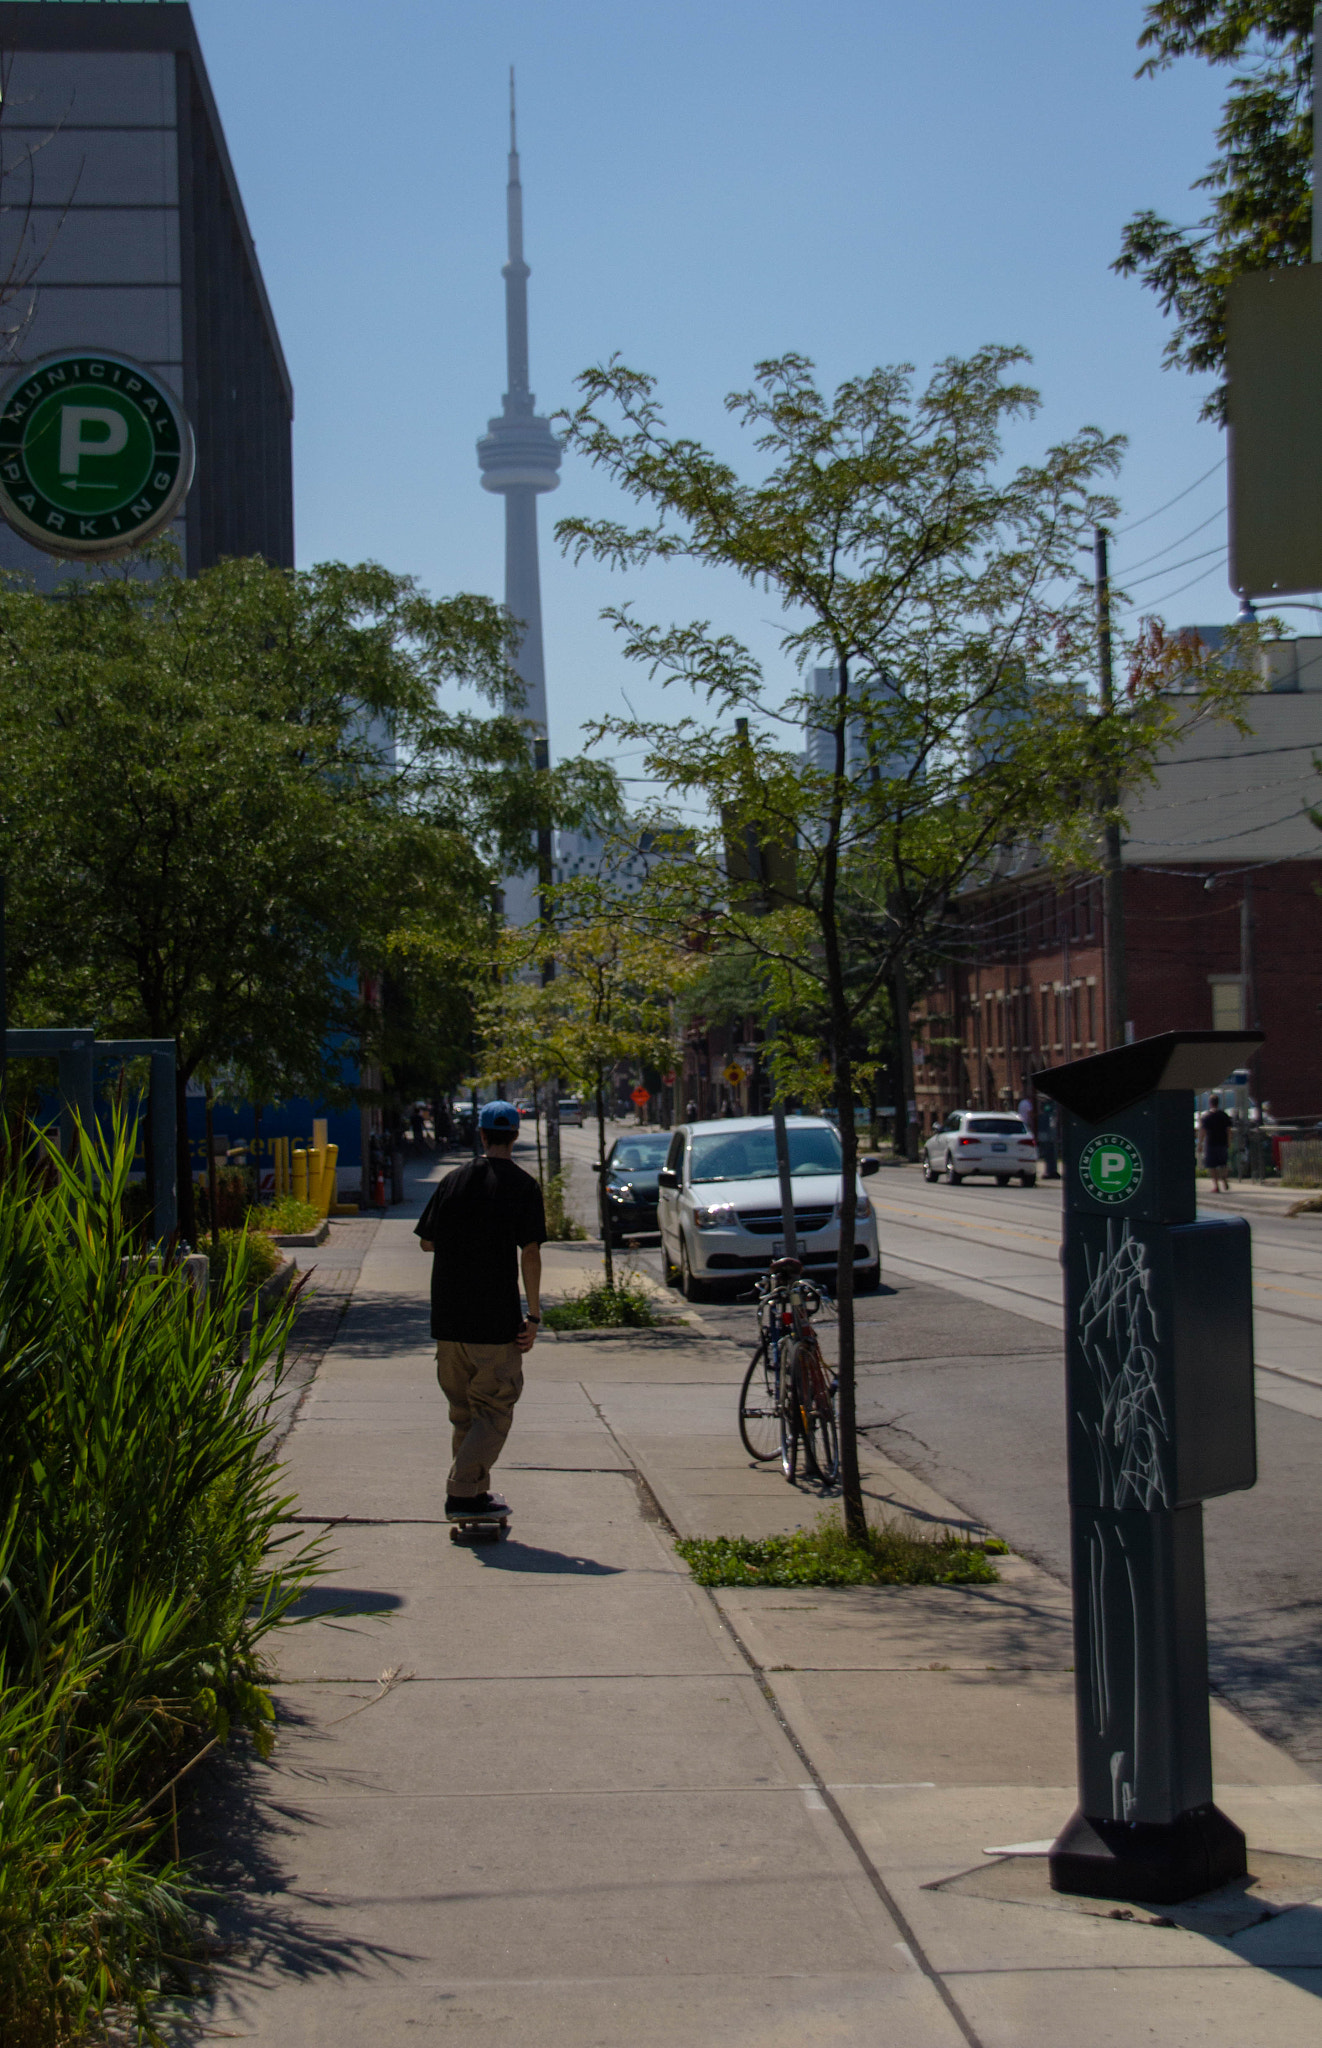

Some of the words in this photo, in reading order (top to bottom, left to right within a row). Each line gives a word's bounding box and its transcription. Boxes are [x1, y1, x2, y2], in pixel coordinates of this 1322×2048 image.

[10, 364, 169, 433] MUNICIPAL
[59, 405, 128, 474] P
[4, 464, 170, 535] PARKING
[1083, 1138, 1138, 1167] MUNICIPAL
[1101, 1153, 1125, 1177] P
[1083, 1174, 1138, 1200] PARKING
